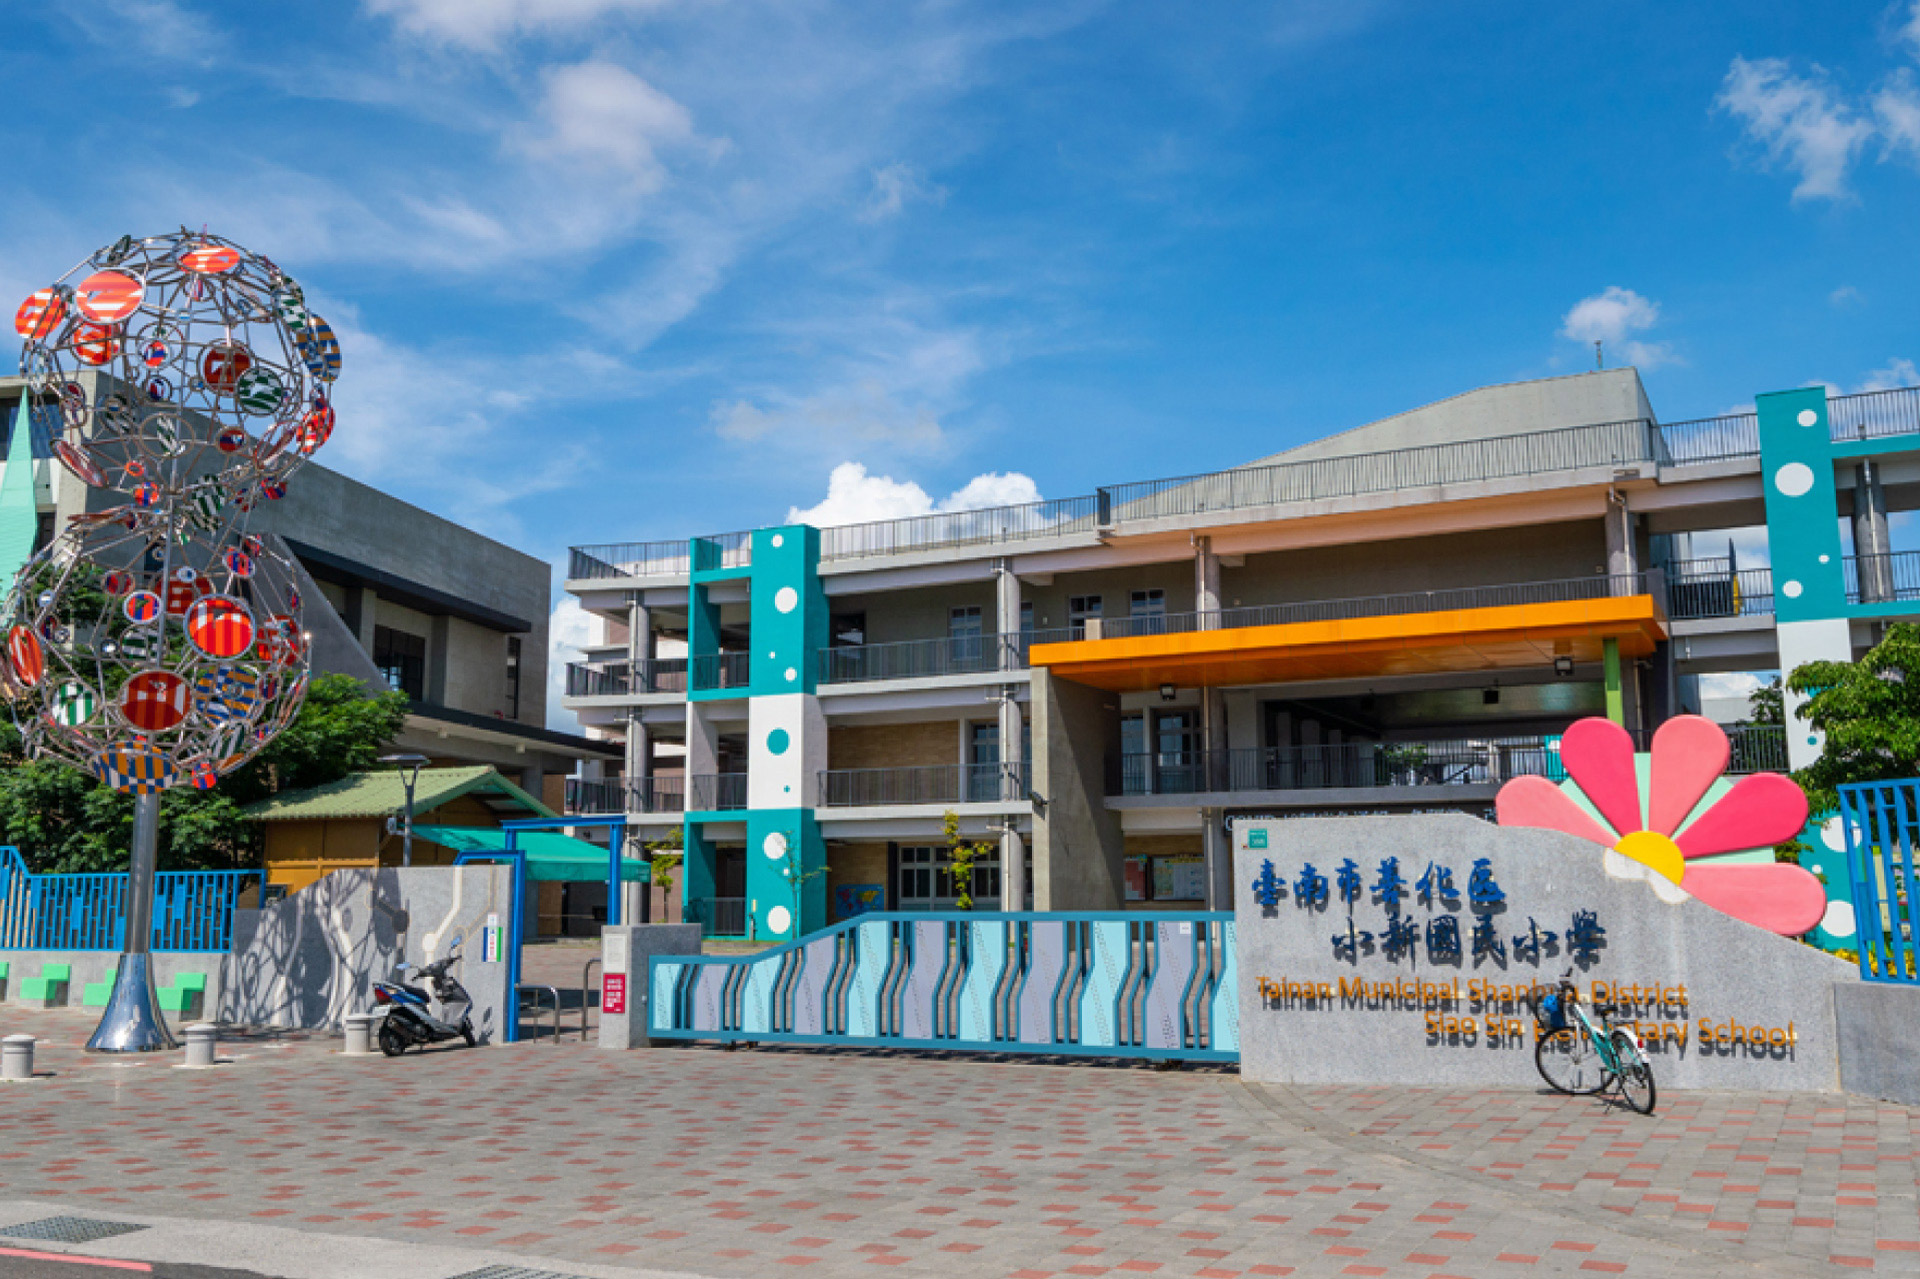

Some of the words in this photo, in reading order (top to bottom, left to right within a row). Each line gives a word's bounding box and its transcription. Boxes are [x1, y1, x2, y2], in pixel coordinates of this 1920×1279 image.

[1331, 908, 1606, 963] 小新國民小學
[1256, 977, 1331, 1000] Tainan
[1338, 977, 1459, 1005] Municipal
[1591, 980, 1689, 1006] District
[1424, 1011, 1477, 1036] Siao
[1484, 1012, 1523, 1036] Sin
[1698, 1017, 1795, 1049] School
